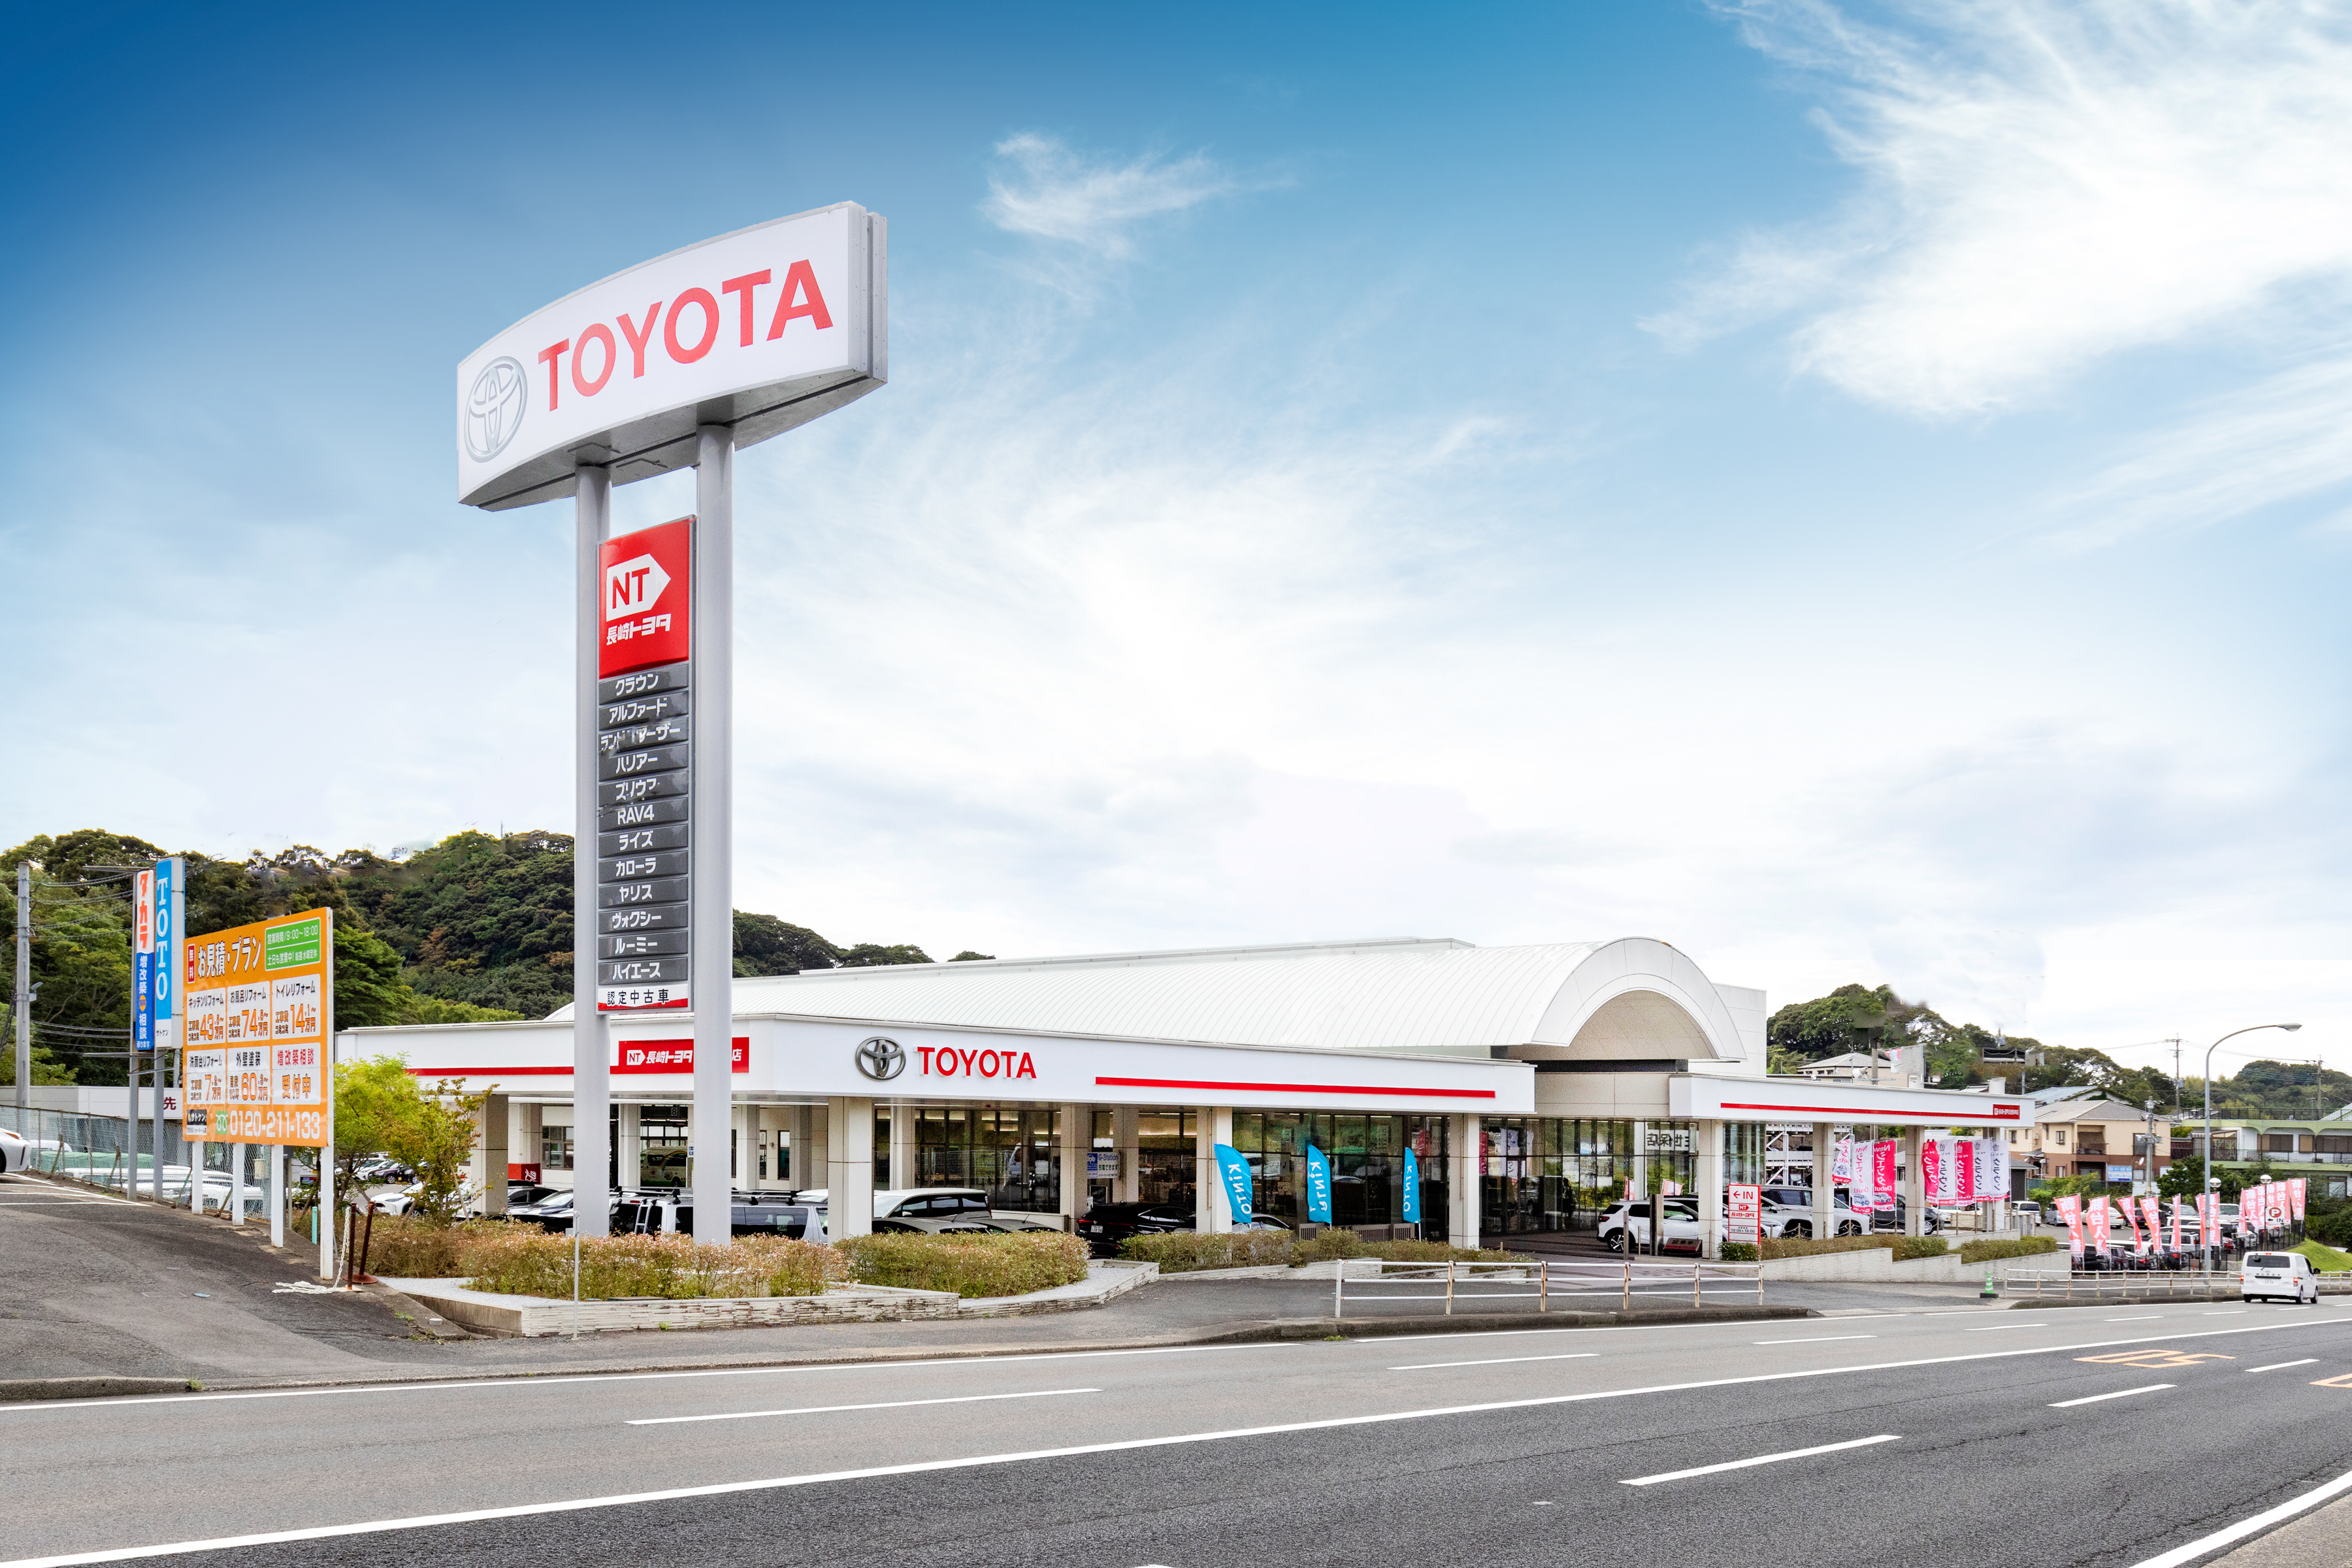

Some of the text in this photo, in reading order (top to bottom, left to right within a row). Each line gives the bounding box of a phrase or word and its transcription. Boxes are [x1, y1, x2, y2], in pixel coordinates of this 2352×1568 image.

[538, 259, 833, 412] TOYOTA
[613, 567, 650, 610] NT
[606, 613, 672, 645] 長崎トヨタ
[615, 673, 659, 696] クラウン
[609, 698, 668, 724] アルファード
[615, 753, 658, 774] ハリアー
[617, 804, 655, 825] RAV4
[619, 830, 654, 851] ライズ
[616, 857, 657, 877] カローラ
[619, 885, 653, 902] ヤリス
[139, 873, 149, 949] タカラ
[612, 911, 662, 929] ヴォクシー
[155, 877, 169, 1001] TOTO
[615, 936, 658, 955] ルーミー
[612, 962, 661, 981] ハイエース
[230, 987, 267, 1004] お風呂リフォーム
[276, 981, 316, 999] トイレリフォーム
[607, 988, 670, 1005] 認定中古車
[189, 993, 224, 1009] キッチンリフォーム
[156, 1029, 169, 1037] サトケン
[277, 1048, 314, 1066] 増改築相談
[629, 1053, 641, 1063] NT
[645, 1050, 693, 1064] 長崎トヨタ
[917, 1046, 1037, 1079] TOYOTA
[282, 1073, 311, 1100] 受付中
[230, 1110, 320, 1139] 0120-211-133
[1743, 1191, 1753, 1200] IN
